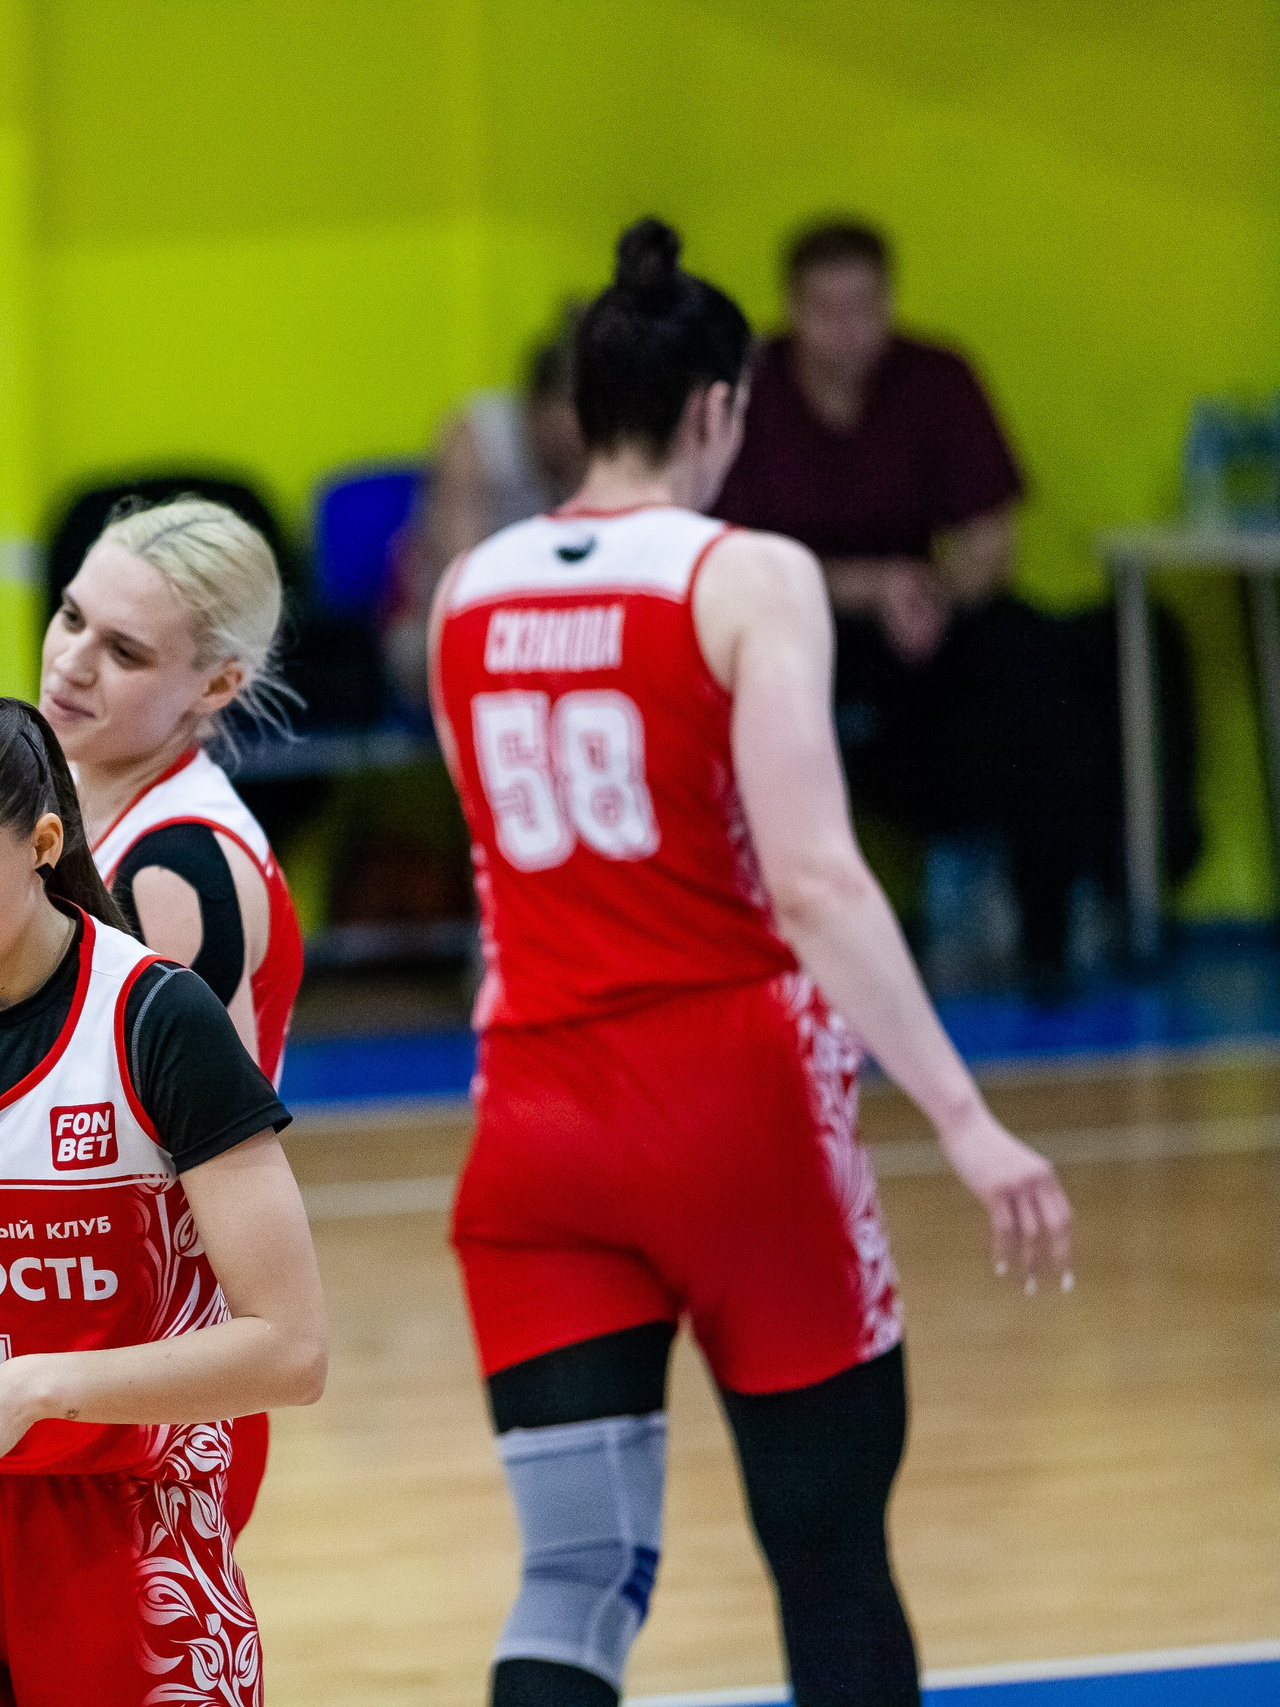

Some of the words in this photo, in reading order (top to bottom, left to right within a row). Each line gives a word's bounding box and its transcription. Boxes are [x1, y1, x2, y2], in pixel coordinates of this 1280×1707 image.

[471, 688, 661, 873] 58
[55, 1109, 111, 1138] FON
[57, 1133, 113, 1163] BET
[46, 1215, 112, 1241] КЛУБ
